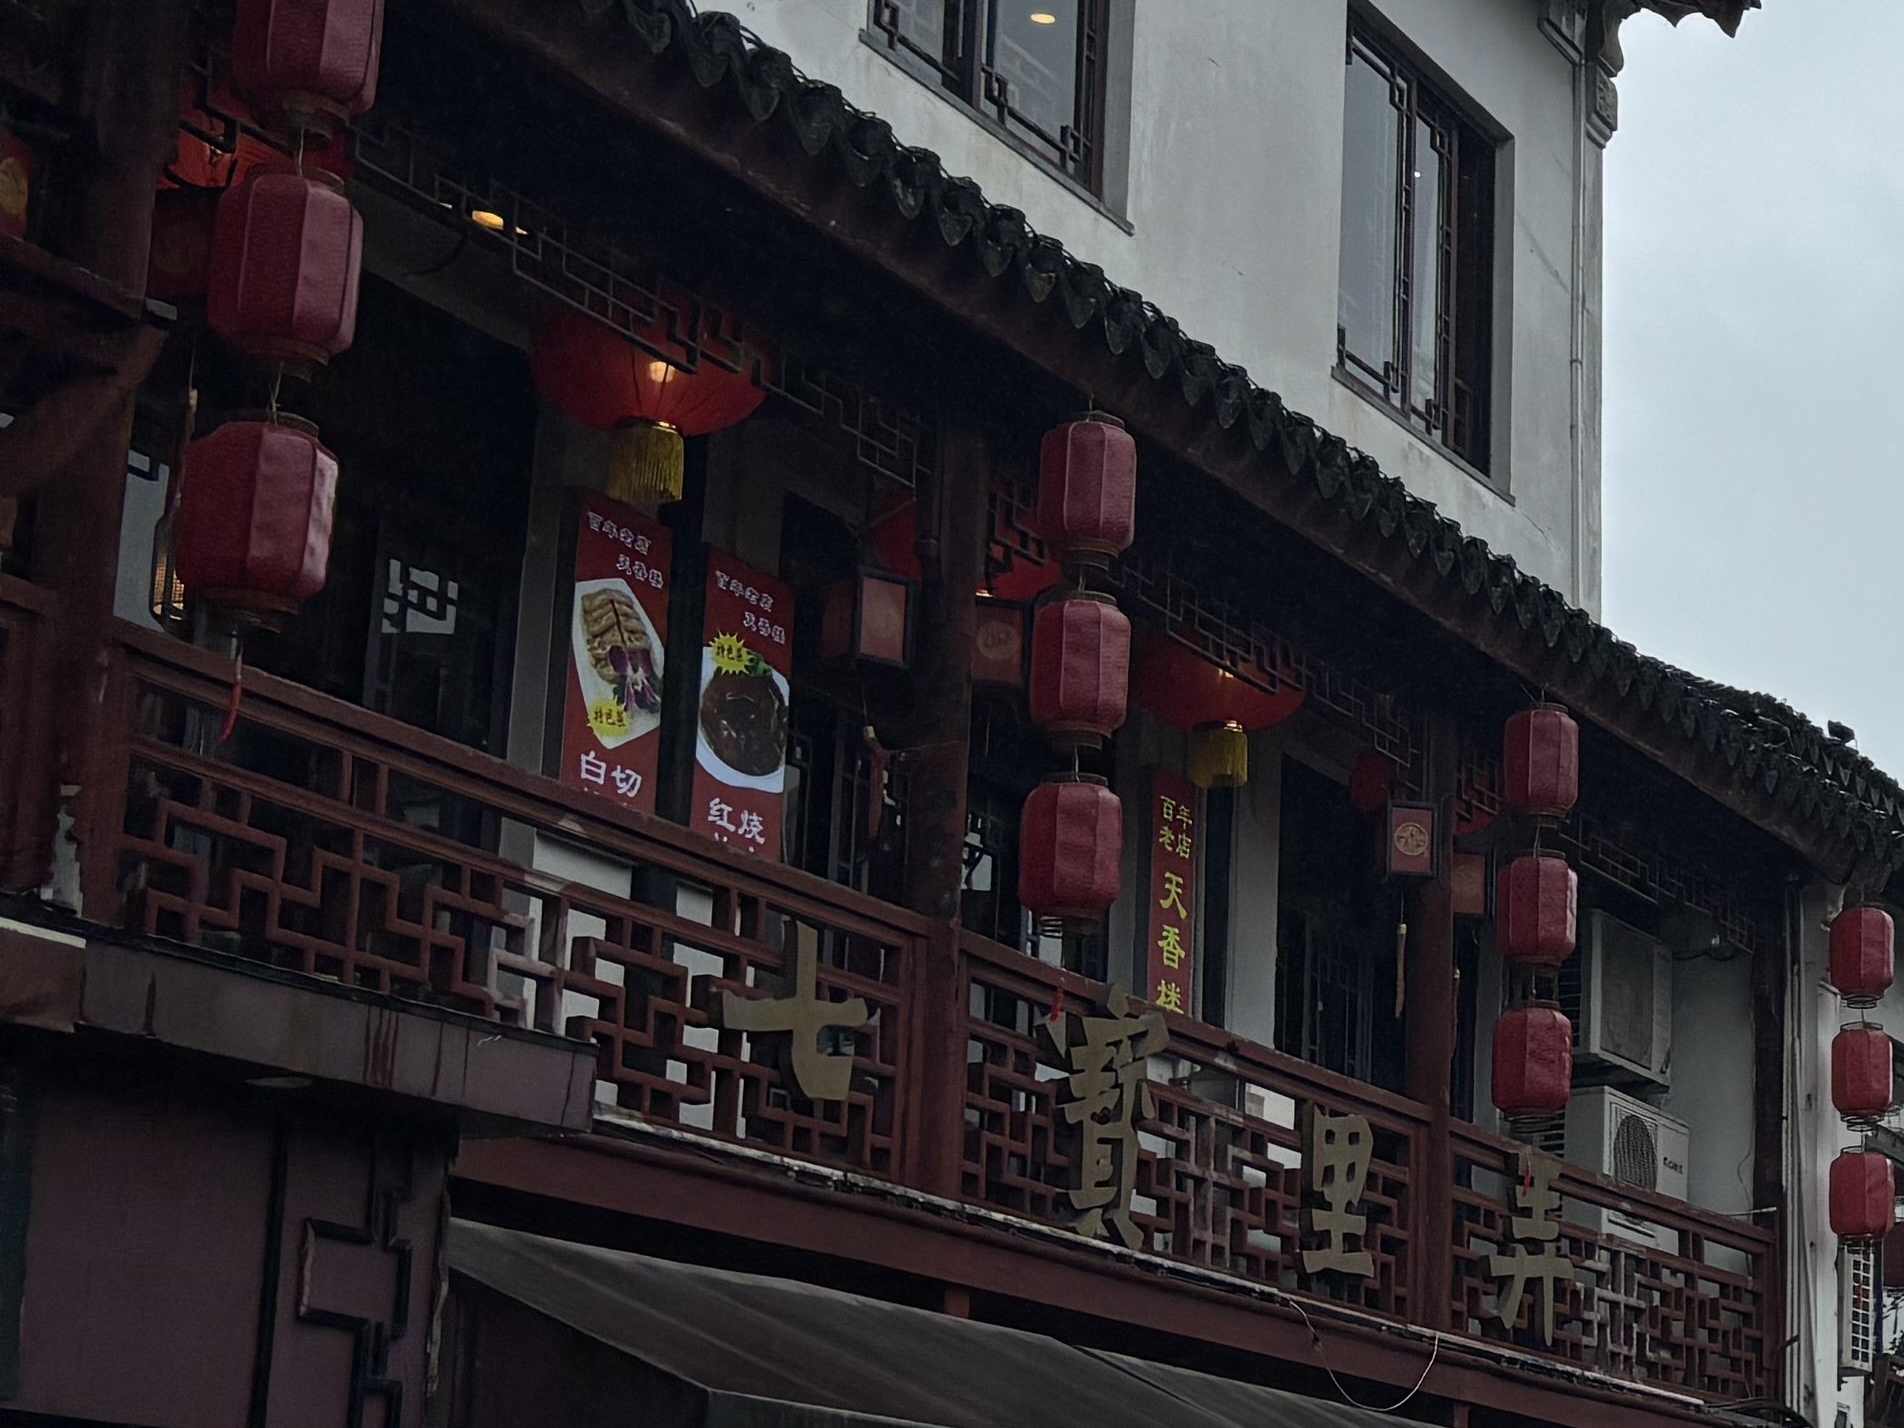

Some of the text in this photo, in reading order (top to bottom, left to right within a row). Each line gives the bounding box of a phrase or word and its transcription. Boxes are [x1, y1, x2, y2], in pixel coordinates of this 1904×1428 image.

[580, 751, 642, 798] 白切
[707, 797, 765, 844] 红烧
[1155, 871, 1188, 1015] 天香楼
